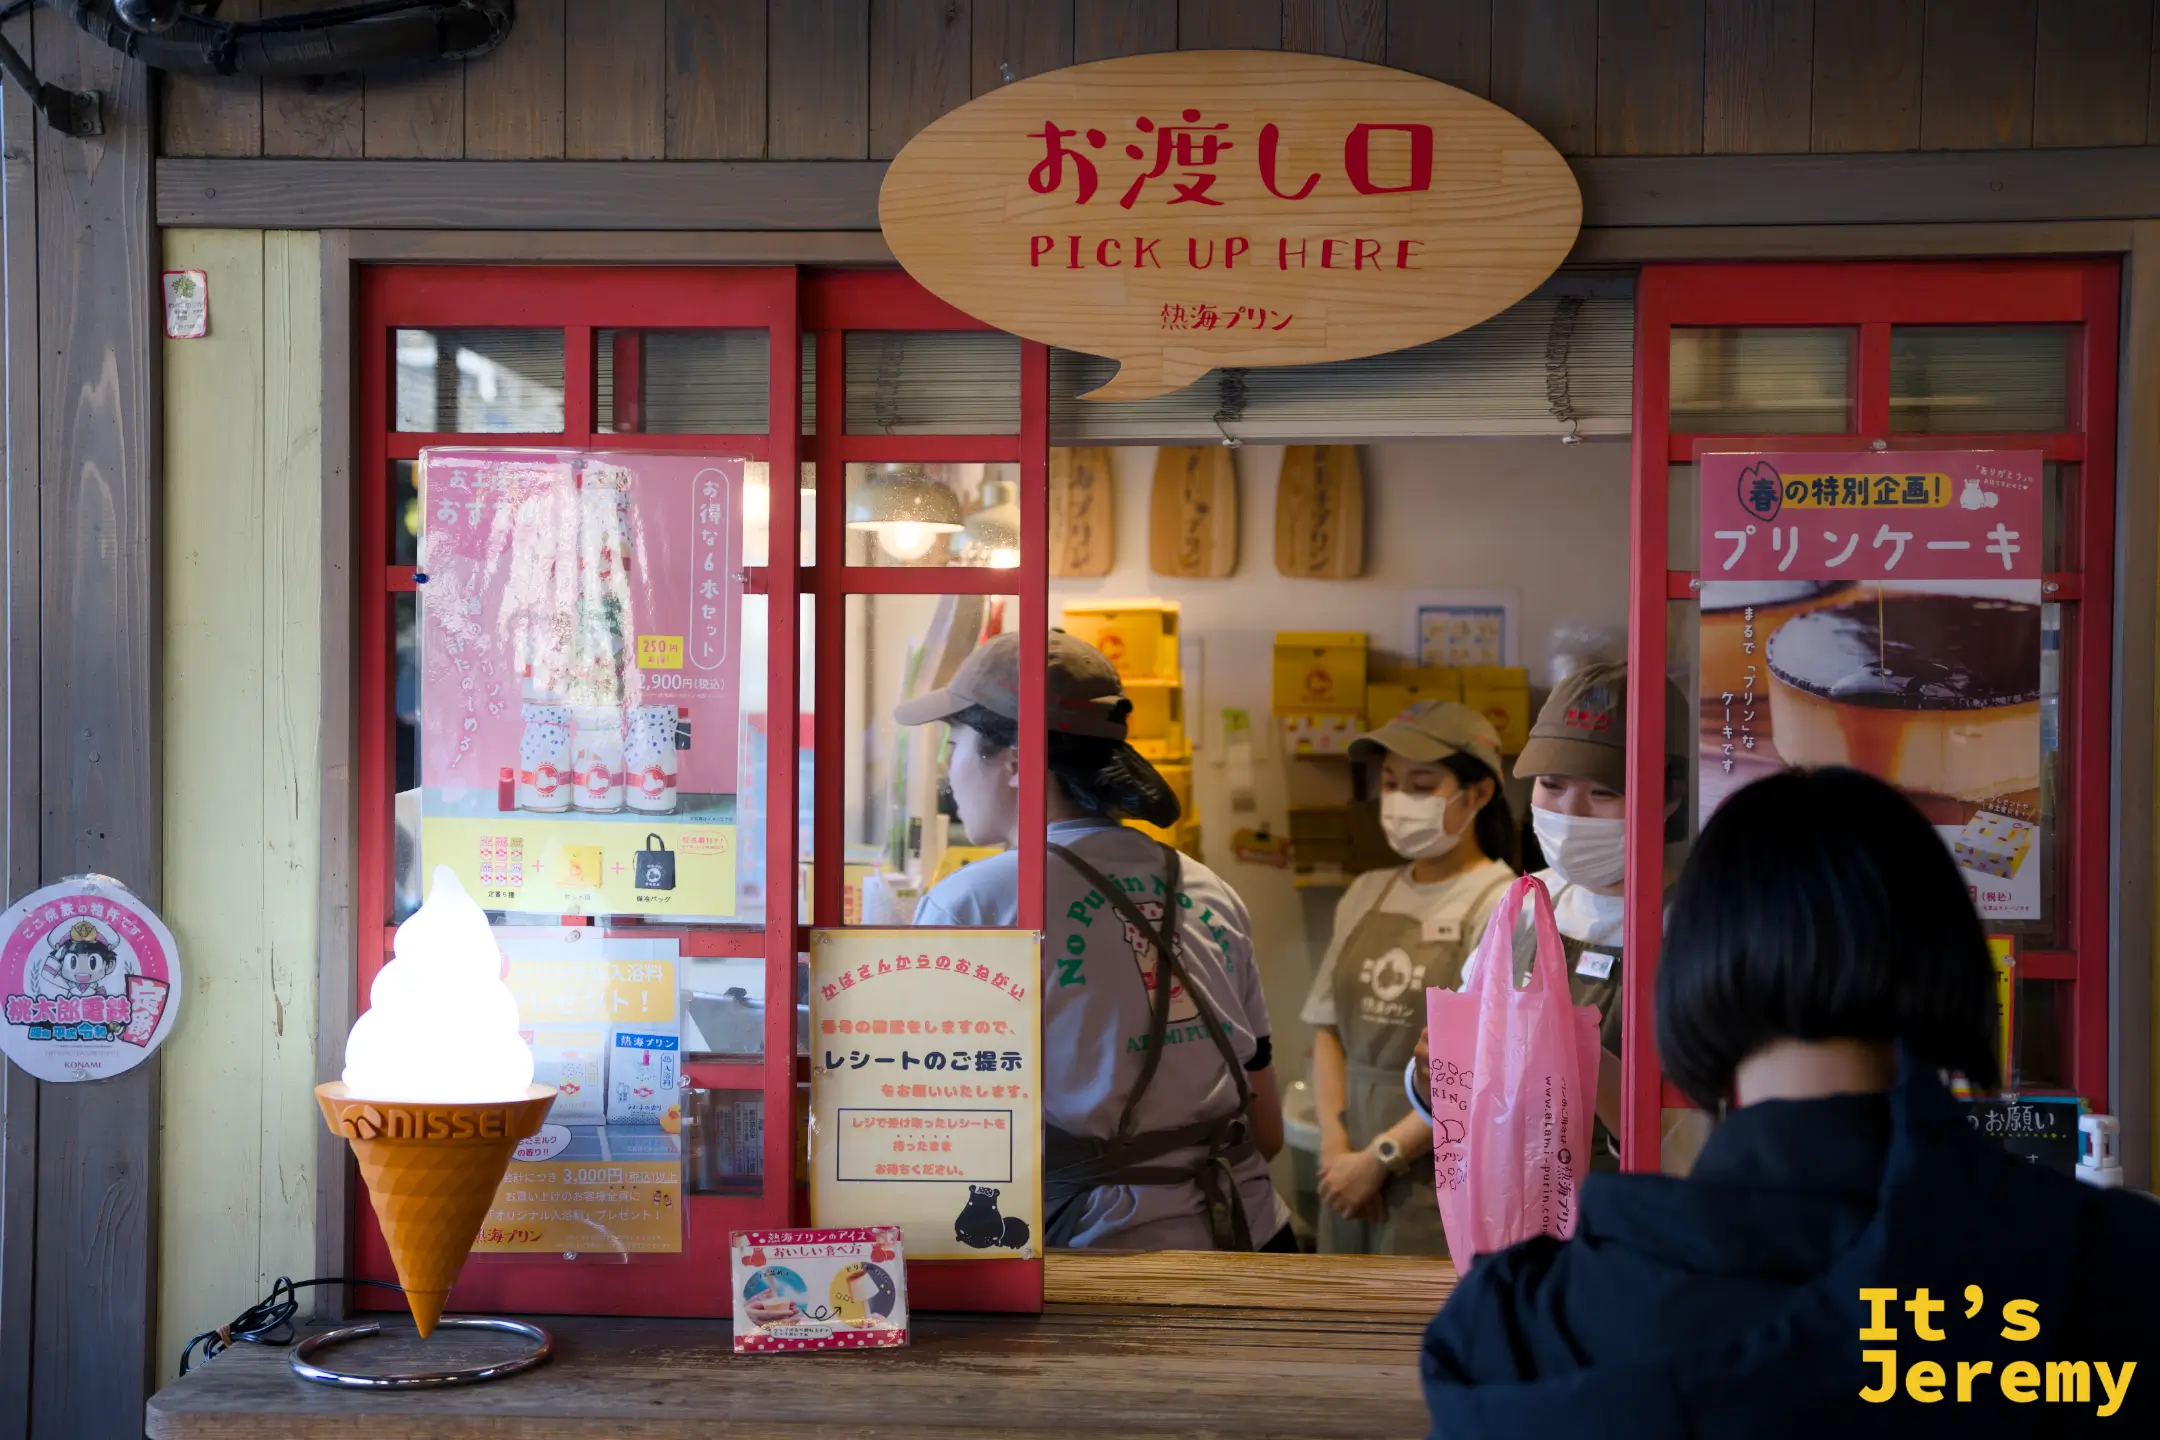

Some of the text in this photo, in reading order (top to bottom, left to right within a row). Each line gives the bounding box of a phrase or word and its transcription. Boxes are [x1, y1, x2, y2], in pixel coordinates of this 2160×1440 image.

[1027, 108, 1433, 209] お渡し口
[1030, 235, 1426, 271] PICK UP HERE
[1160, 302, 1294, 331] 熱海プリン
[1749, 474, 1942, 513] 春の特別企画!
[1713, 522, 2022, 572] プリンケーキ
[700, 480, 722, 657] お得な6本セット
[643, 639, 678, 653] 250円
[1741, 606, 1756, 750] まるで「プリン」な
[1721, 691, 1734, 775] ケーキです
[1066, 873, 1146, 928] Puin
[821, 954, 1025, 1001] かばさんからのおねがい
[1057, 934, 1088, 989] No
[7, 995, 132, 1023] 桃太郎電鉄
[620, 1034, 675, 1048] 熱海プリン
[64, 1061, 102, 1069] KONAMI
[825, 1050, 1023, 1072] レシートのご提示
[881, 1083, 1030, 1099] をお願いいたします。
[875, 1162, 965, 1177] お待ちください。
[505, 1190, 641, 1202] お買い上げのお客様全員に
[1555, 1165, 1574, 1237] 熱海プリン
[767, 1230, 868, 1245] 熱海プリンのアイス
[773, 1242, 863, 1258] おいしい食べ方
